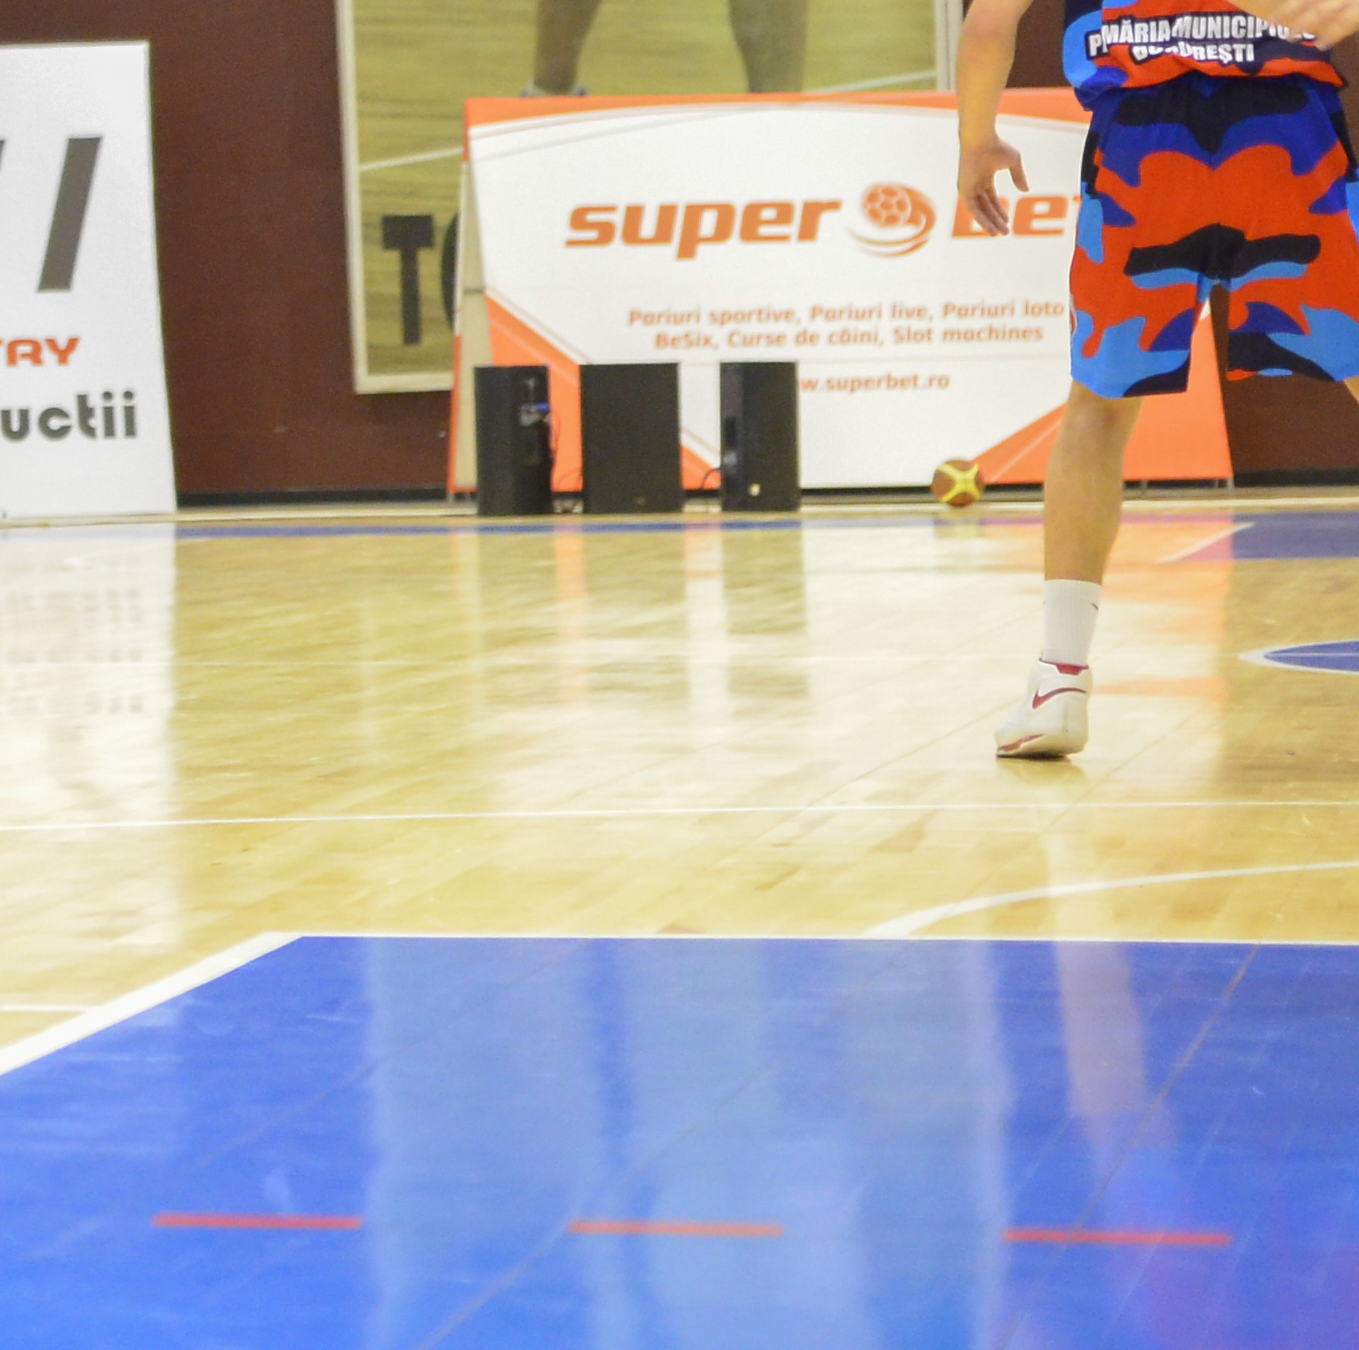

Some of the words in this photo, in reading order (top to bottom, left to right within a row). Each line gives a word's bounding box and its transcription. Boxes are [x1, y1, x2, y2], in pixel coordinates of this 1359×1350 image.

[565, 199, 842, 261] super
[629, 306, 701, 326] Pariuri
[709, 306, 802, 327] sportive,
[811, 303, 882, 323] Pariuri
[892, 302, 934, 322] live,
[943, 300, 1016, 319] Pariuri
[1024, 299, 1065, 317] loto
[728, 331, 787, 347] Curse
[795, 329, 820, 346] de
[894, 326, 934, 344] Slot
[943, 324, 1044, 342] machines
